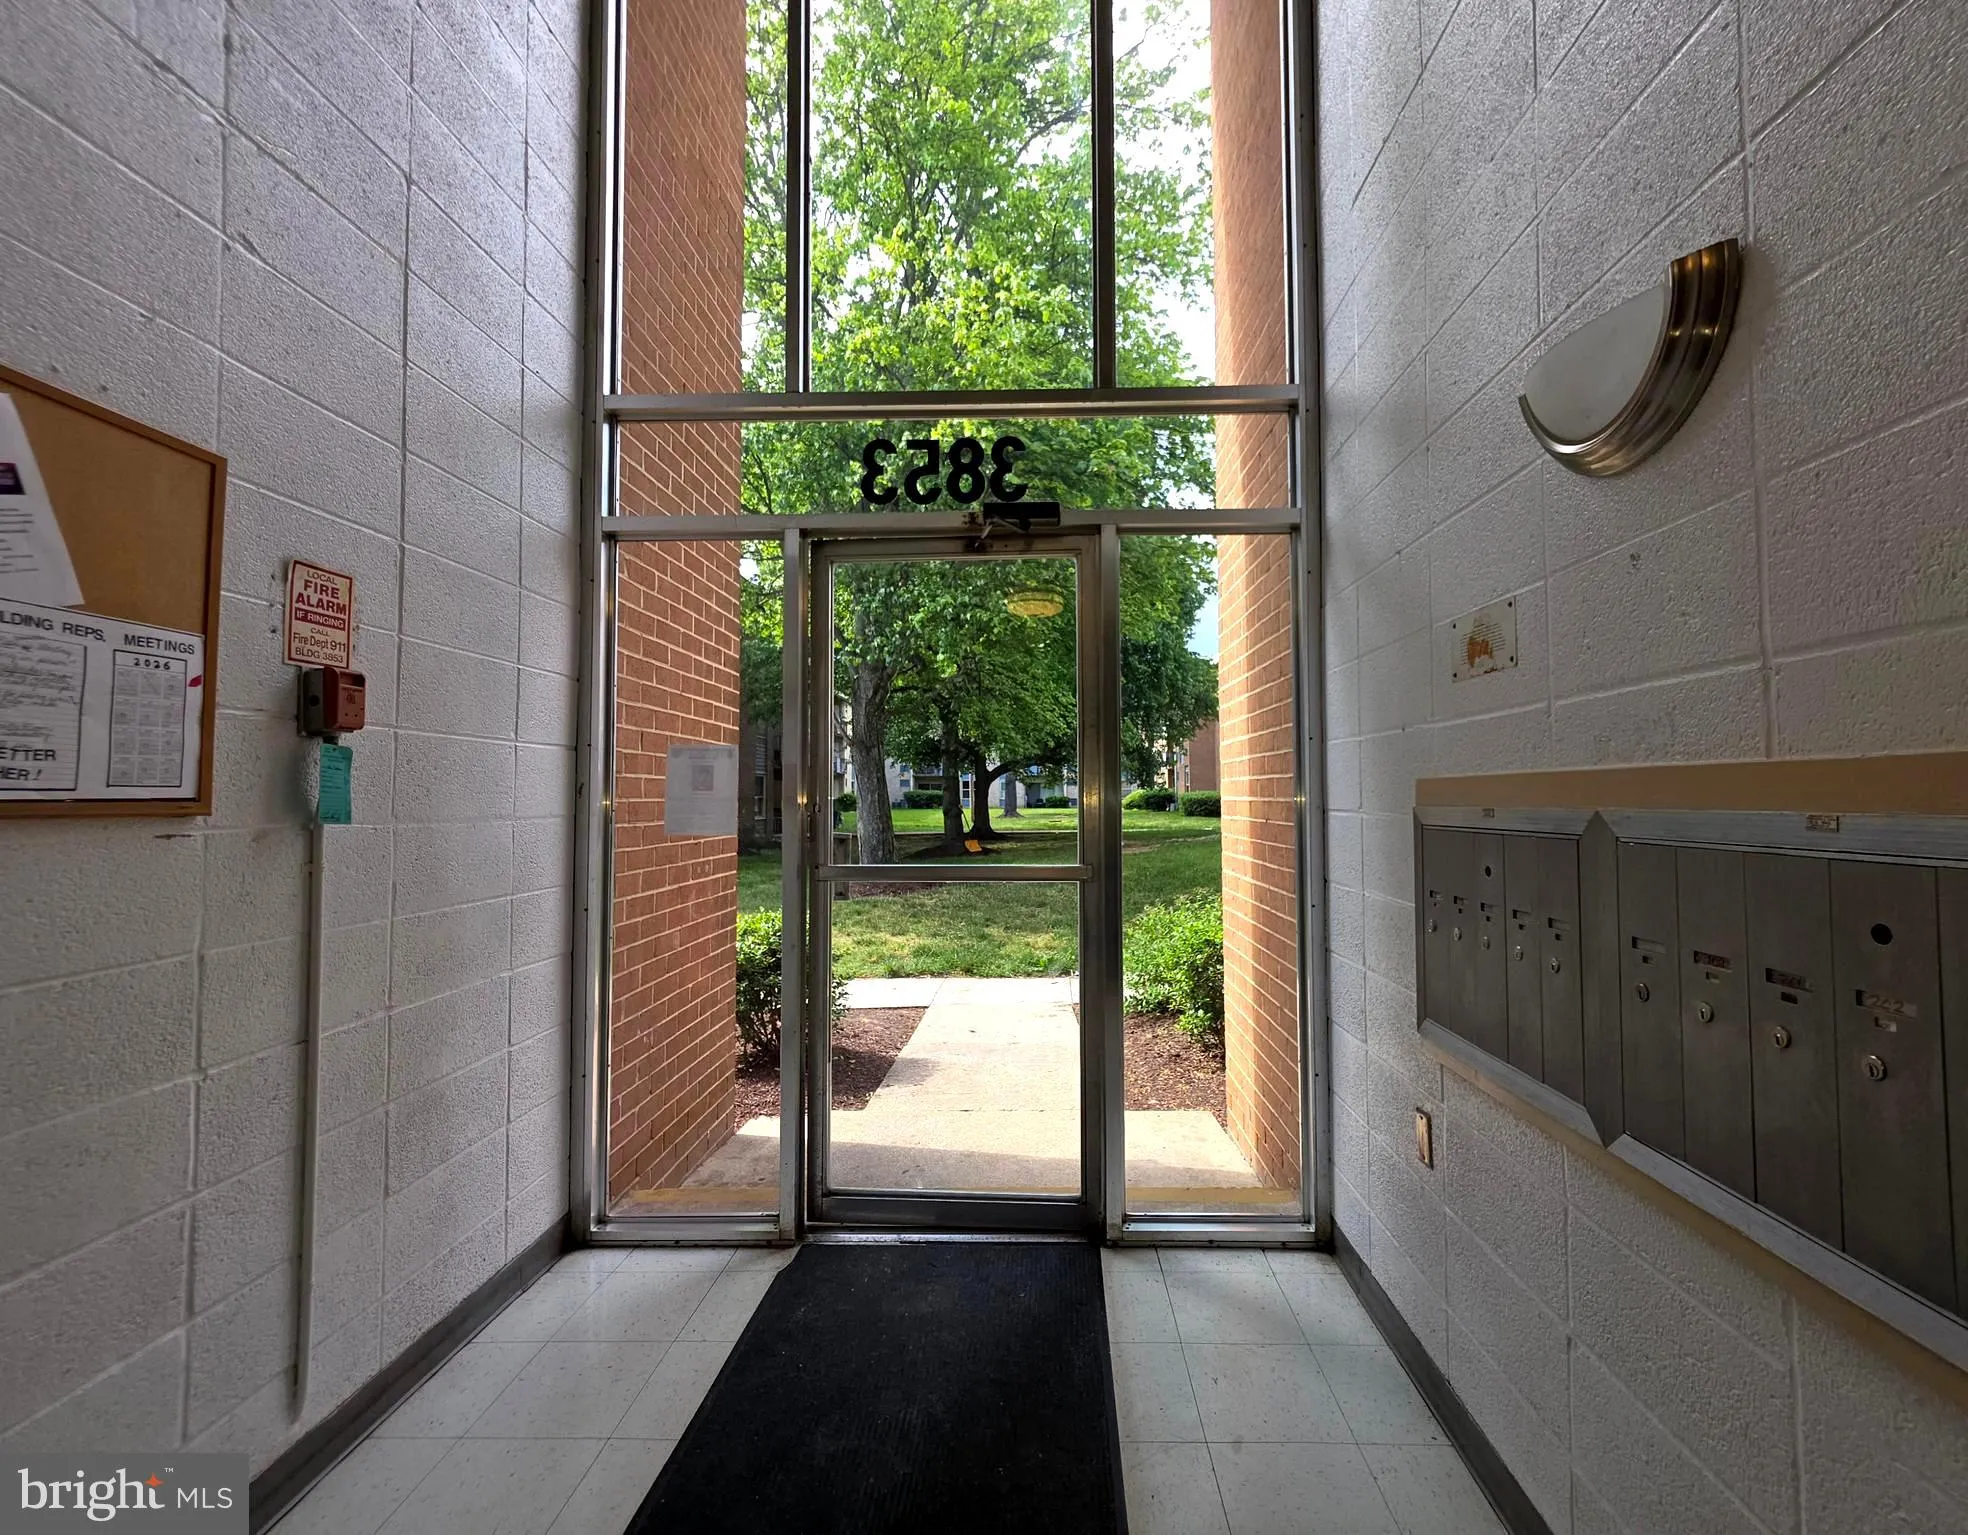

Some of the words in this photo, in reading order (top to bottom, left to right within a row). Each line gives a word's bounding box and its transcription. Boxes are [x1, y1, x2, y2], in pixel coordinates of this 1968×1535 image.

[306, 570, 338, 586] LOCAL
[303, 579, 340, 600] FIRE
[295, 592, 347, 617] ALARM
[296, 609, 305, 619] IF
[307, 611, 344, 629] RINGING
[62, 622, 106, 643] REPS.
[123, 633, 195, 655] MEETINGS
[310, 627, 330, 637] CALL
[293, 632, 309, 646] Fire
[310, 635, 329, 650] Dept
[330, 640, 347, 653] 911
[133, 657, 171, 671] 2026
[295, 647, 321, 659] BLDG
[322, 651, 344, 664] 3853
